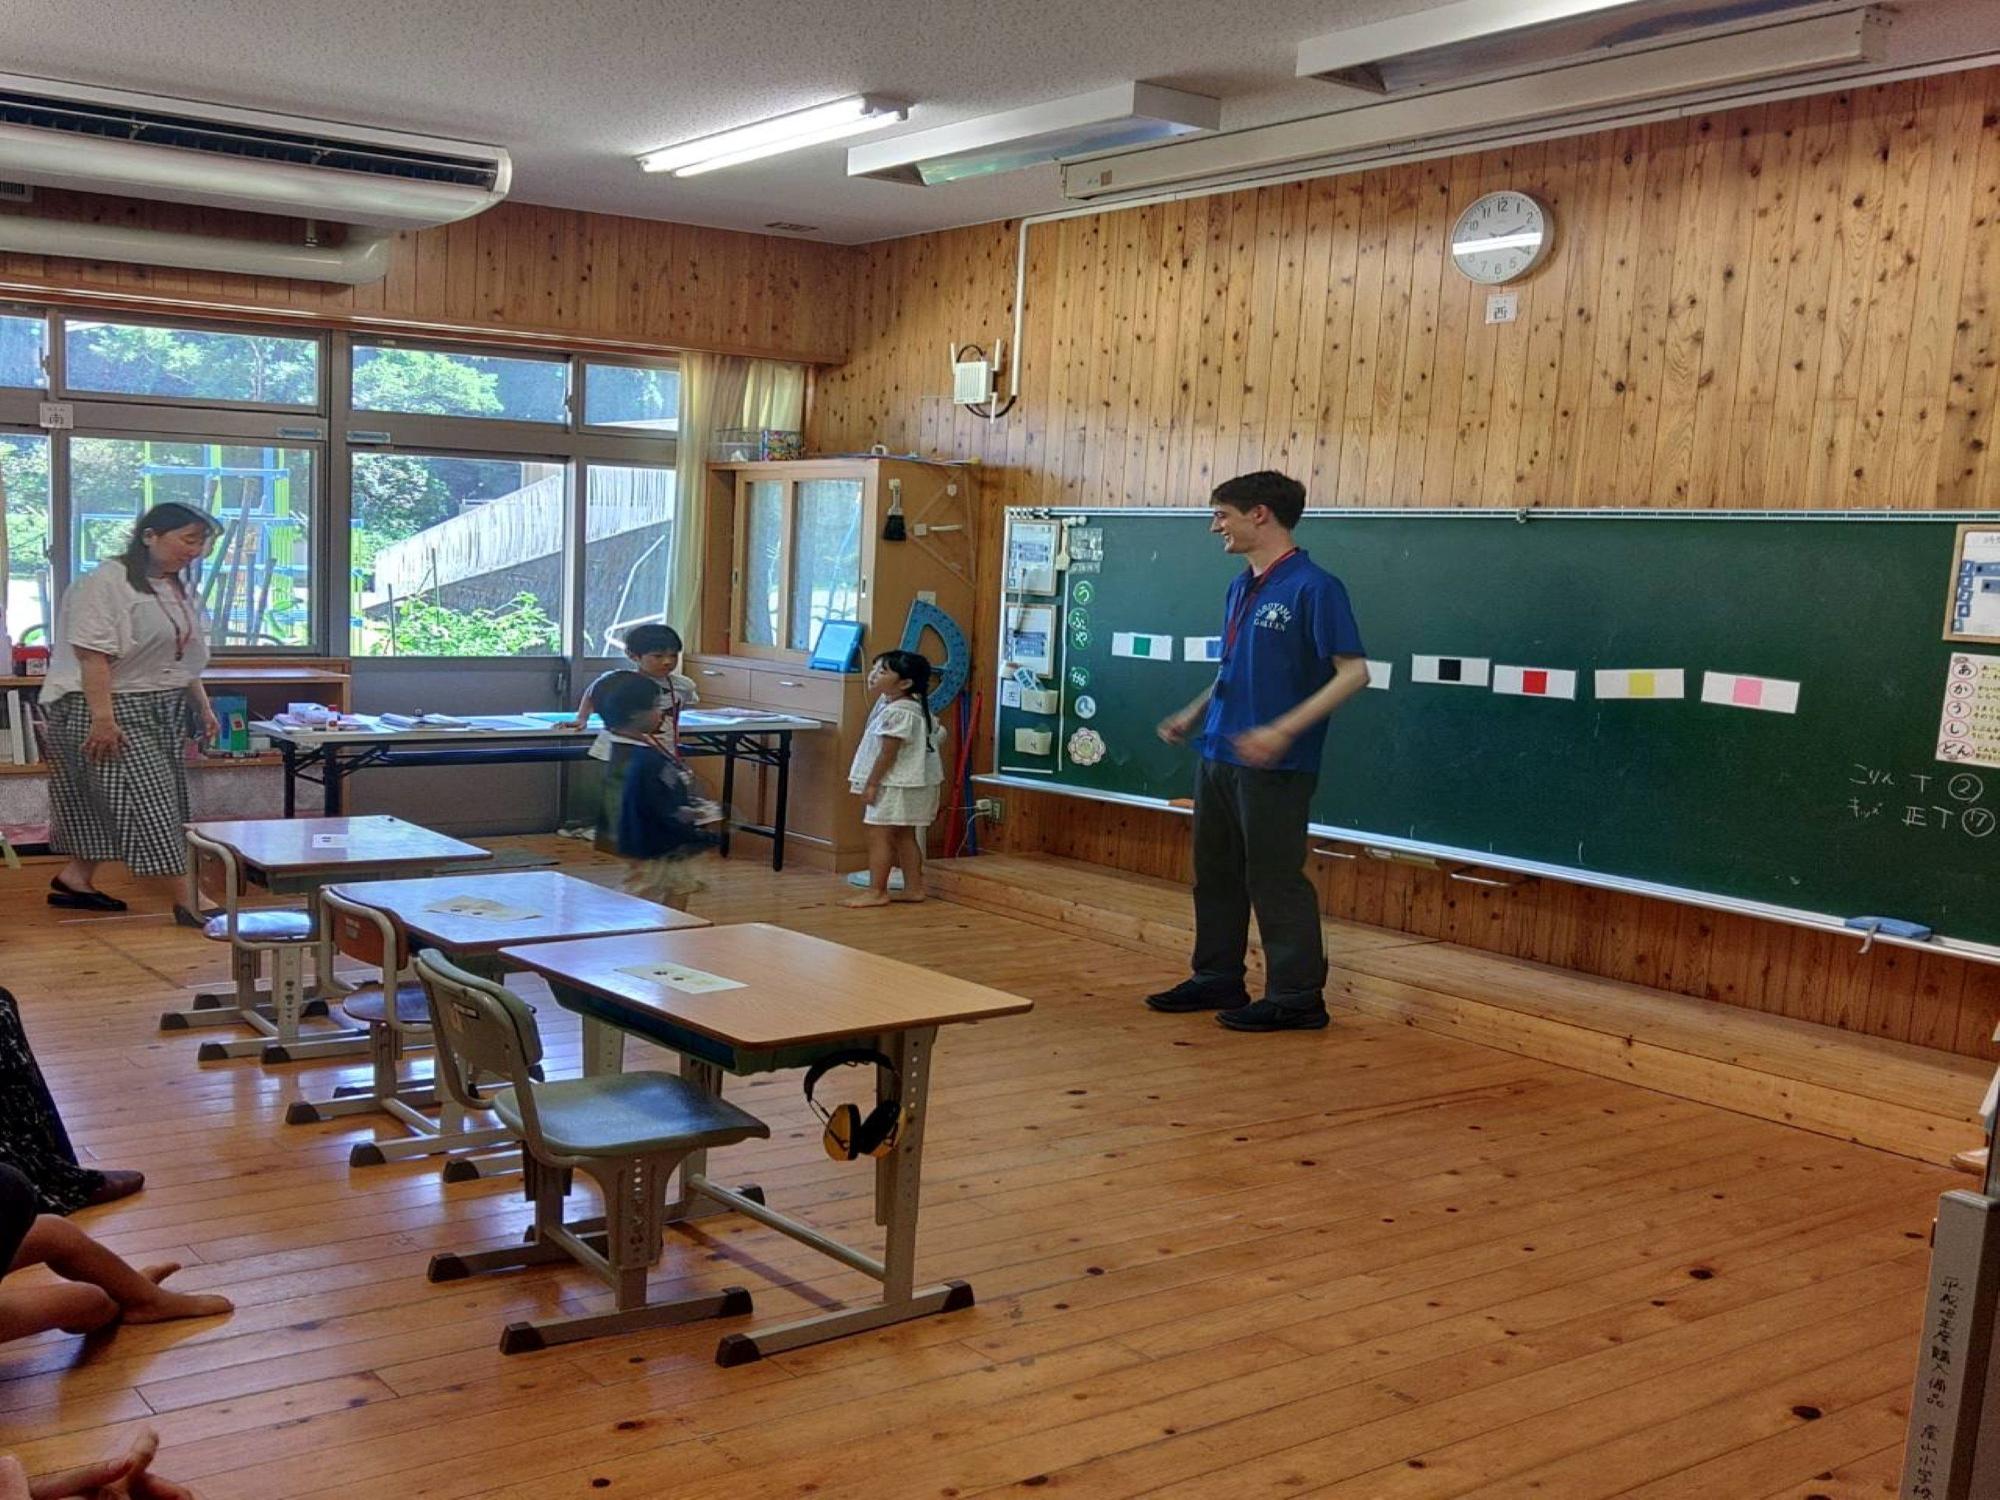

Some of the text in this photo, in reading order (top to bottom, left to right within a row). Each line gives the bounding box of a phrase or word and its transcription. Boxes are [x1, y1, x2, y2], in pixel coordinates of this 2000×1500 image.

[1497, 200, 1508, 212] 12
[1482, 207, 1491, 218] 11
[1526, 213, 1534, 224] 2
[1469, 220, 1479, 231] 10
[1480, 261, 1488, 272] 7
[1494, 263, 1502, 274] 6
[1510, 257, 1517, 269] 5
[1494, 306, 1508, 319] 西
[1958, 664, 1972, 676] あ
[1953, 684, 1968, 695] か
[1952, 702, 1962, 714] う
[1950, 723, 1960, 734] し
[1942, 742, 1970, 757] どん
